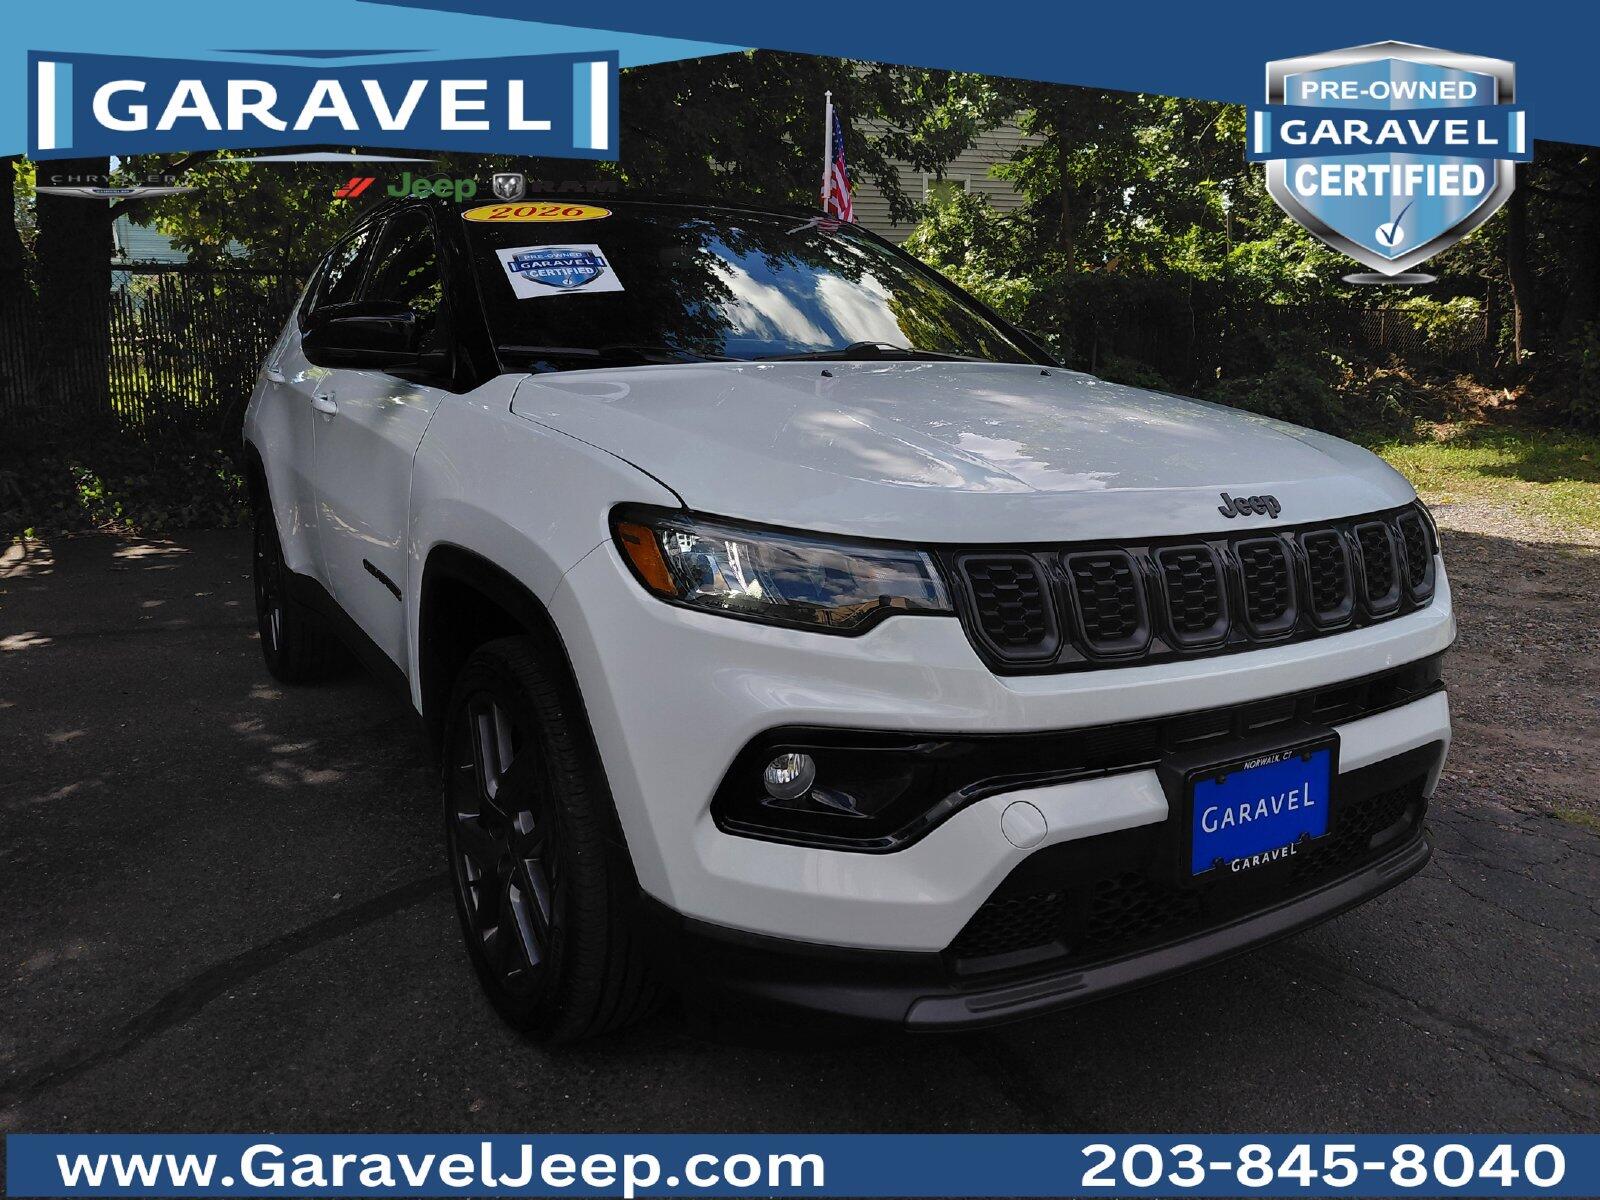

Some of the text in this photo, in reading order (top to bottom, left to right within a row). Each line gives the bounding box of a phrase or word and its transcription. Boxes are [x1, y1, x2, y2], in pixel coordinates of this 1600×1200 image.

[488, 206, 584, 219] 2026
[523, 252, 583, 260] PRE-OWNED
[520, 258, 595, 269] GARAVEL
[529, 267, 595, 277] CERTIFIED
[1218, 492, 1281, 519] Jeep
[1282, 751, 1293, 760] CT
[1201, 782, 1315, 833] GARAVEL
[1231, 842, 1298, 872] GARAVEL
